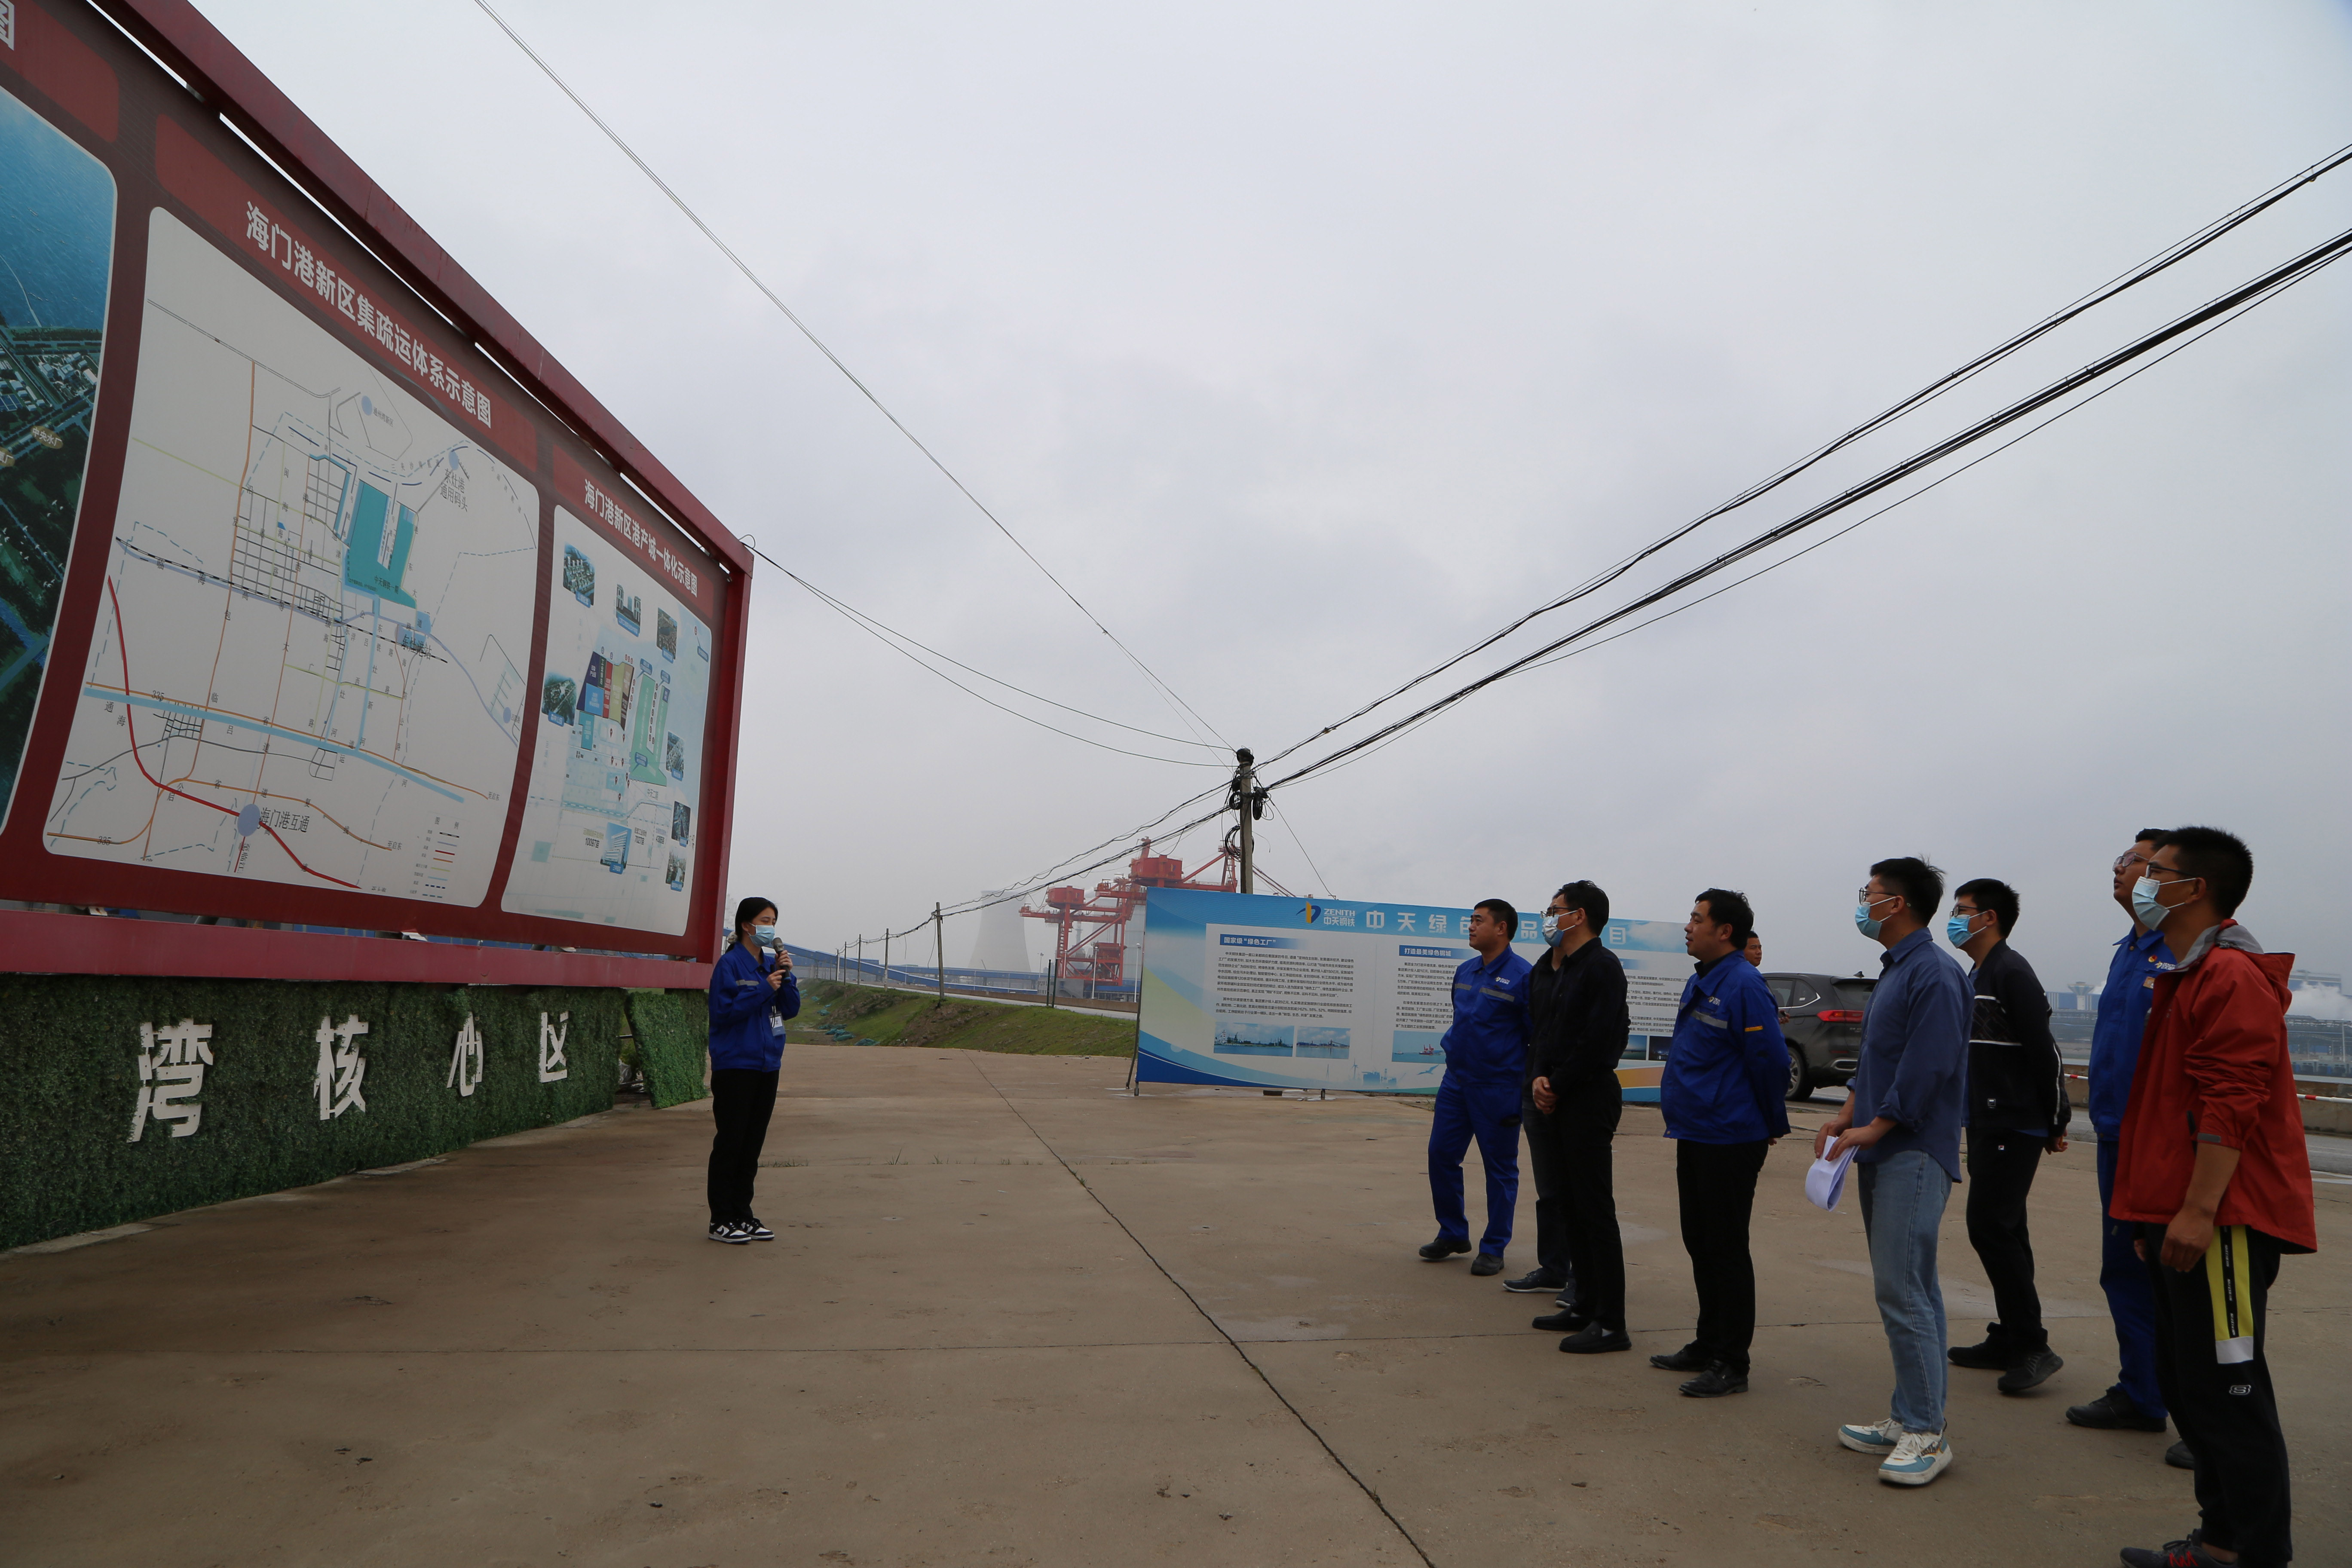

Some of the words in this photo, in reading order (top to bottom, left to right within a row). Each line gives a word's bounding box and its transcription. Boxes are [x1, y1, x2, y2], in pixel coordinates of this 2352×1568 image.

[247, 201, 491, 428] 海门港新区集疏运体系示意图
[33, 427, 62, 446] 中央水厂
[440, 483, 468, 513] 通用码头
[585, 479, 697, 597] 海门港新区港产城一体化示意图
[151, 690, 165, 701] 335
[104, 701, 113, 713] 通
[259, 807, 309, 833] 海门港互通
[1324, 917, 1355, 927] 中天钢铁
[1521, 920, 1537, 939] 品
[1224, 937, 1277, 946] 国家级“绿色工厂”
[1404, 948, 1452, 957] 打造最美绿色钢城
[127, 1019, 214, 1143] 湾
[314, 1015, 369, 1121] 核
[539, 1011, 569, 1083] 区
